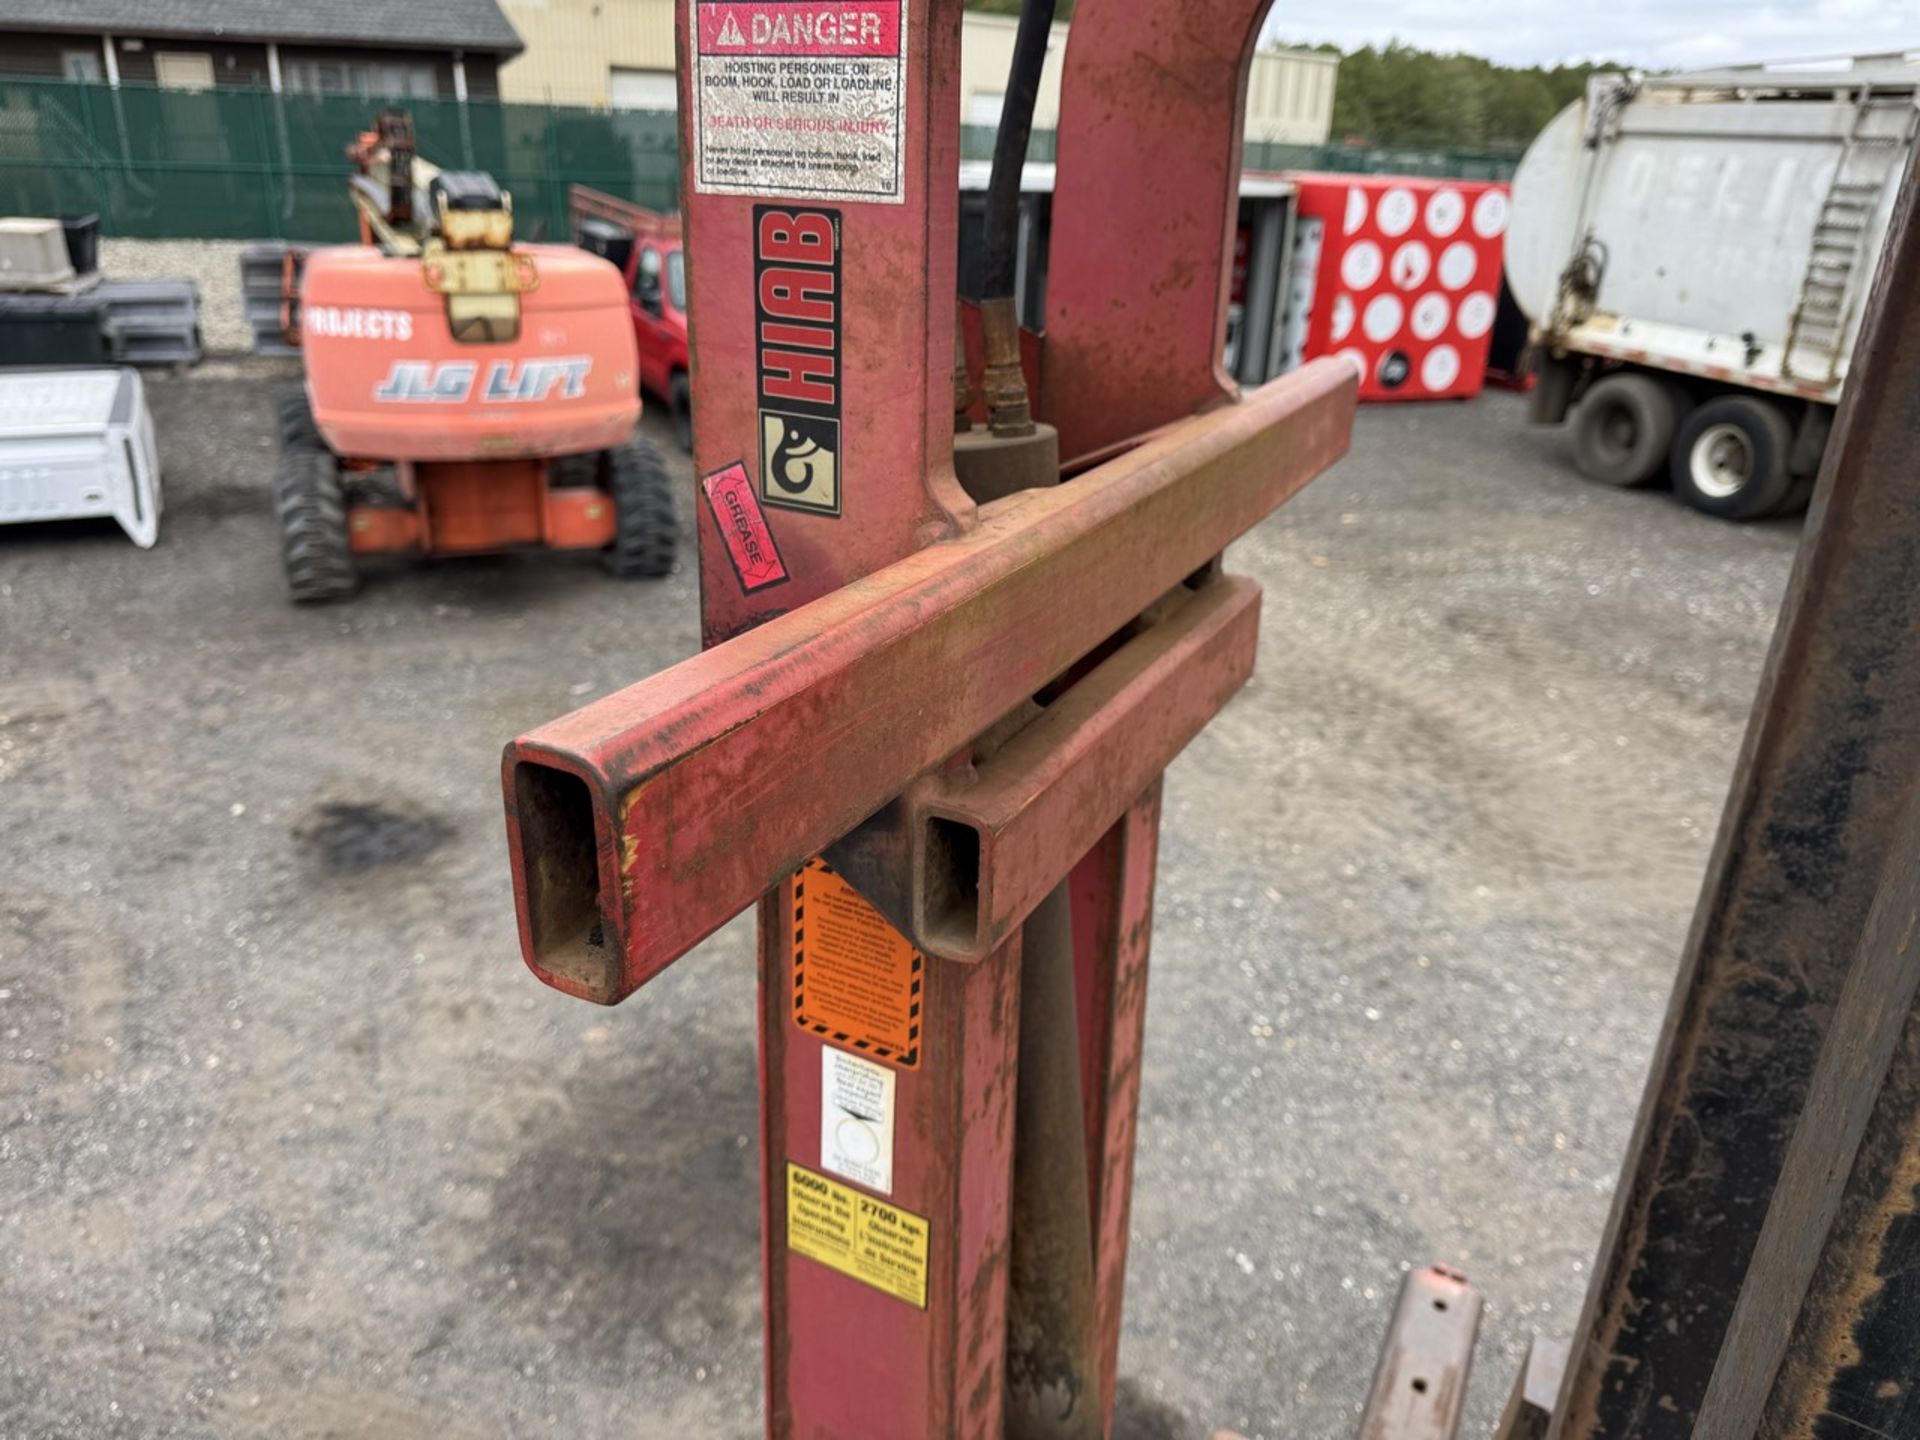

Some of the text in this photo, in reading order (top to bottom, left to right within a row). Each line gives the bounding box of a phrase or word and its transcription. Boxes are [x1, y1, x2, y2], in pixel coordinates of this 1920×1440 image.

[752, 12, 881, 45] DANGER
[724, 62, 870, 76] HOISTING PERSONNEL ON
[705, 76, 740, 88] BOOM,
[780, 78, 811, 89] LOAD
[814, 79, 831, 90] OR
[834, 79, 892, 92] LOADLINE
[753, 91, 840, 103] WILL RESULT IN
[708, 116, 889, 134] DEATH OR SERIOUS INJURY
[760, 159, 796, 168] attached
[881, 181, 892, 191] 10
[759, 210, 835, 405] HIAB
[374, 354, 594, 404] JLG LIFT
[725, 490, 763, 566] GREASE
[792, 1171, 828, 1195] 6000
[861, 1200, 897, 1225] 2700
